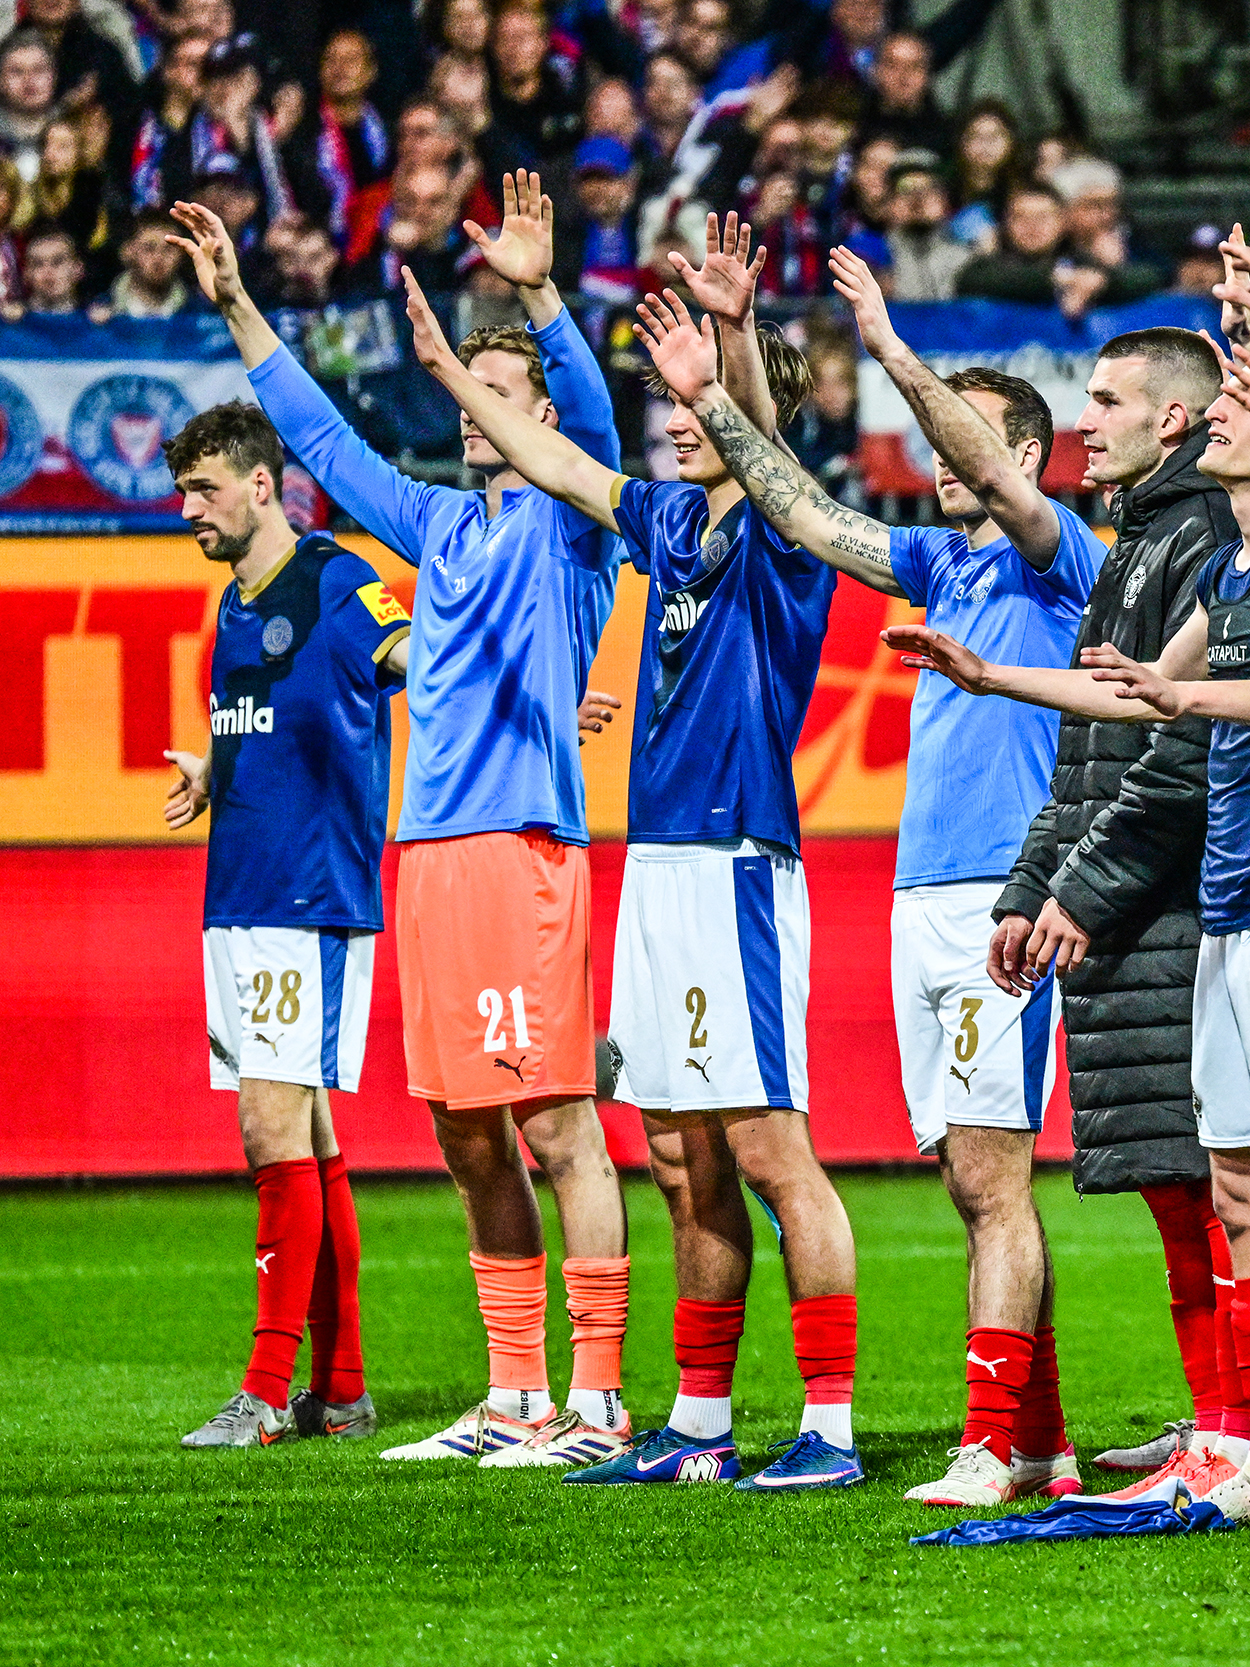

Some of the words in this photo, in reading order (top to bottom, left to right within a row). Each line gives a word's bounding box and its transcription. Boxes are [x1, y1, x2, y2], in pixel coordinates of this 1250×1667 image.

[454, 577, 467, 593] 21
[955, 585, 965, 600] 3
[1207, 645, 1248, 662] CATAPULT
[251, 970, 302, 1025] 28
[478, 986, 532, 1053] 21
[686, 987, 708, 1049] 2
[955, 998, 982, 1063] 3
